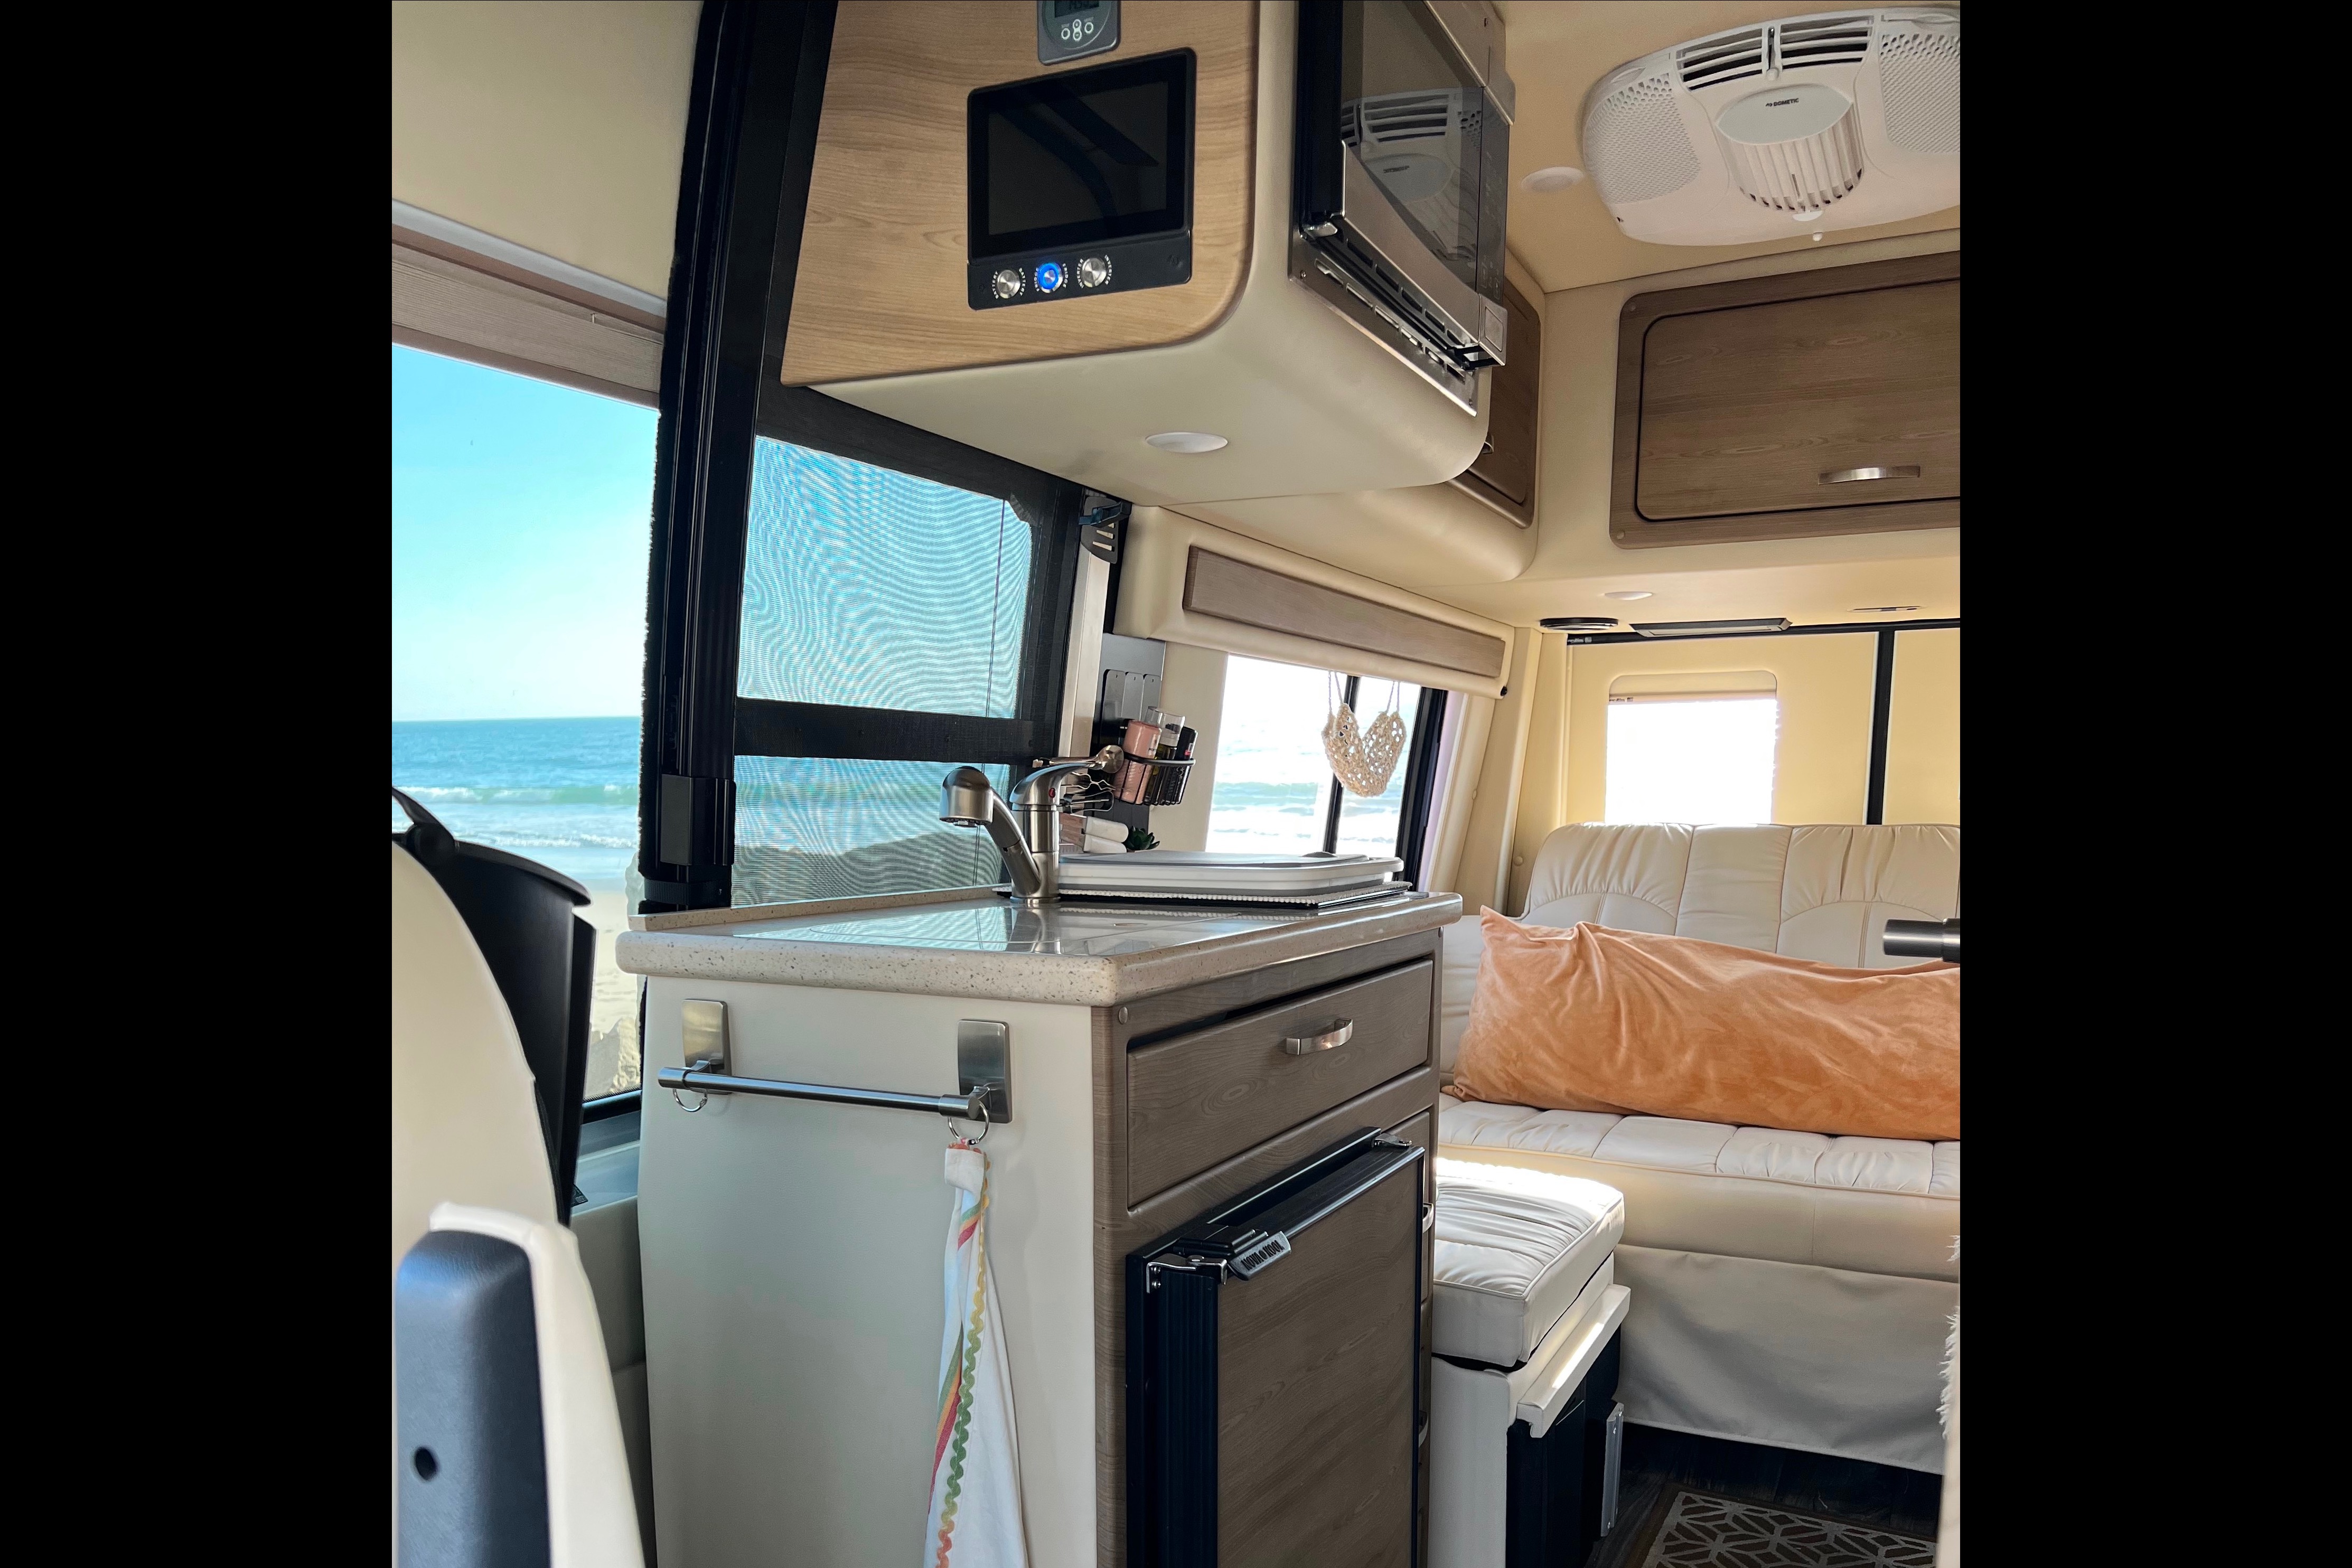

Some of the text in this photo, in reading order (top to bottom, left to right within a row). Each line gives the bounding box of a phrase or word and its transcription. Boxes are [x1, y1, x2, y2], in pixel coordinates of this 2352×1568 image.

[1773, 98, 1799, 107] DOMETIC
[1240, 1240, 1285, 1271] NOVA KOOL
